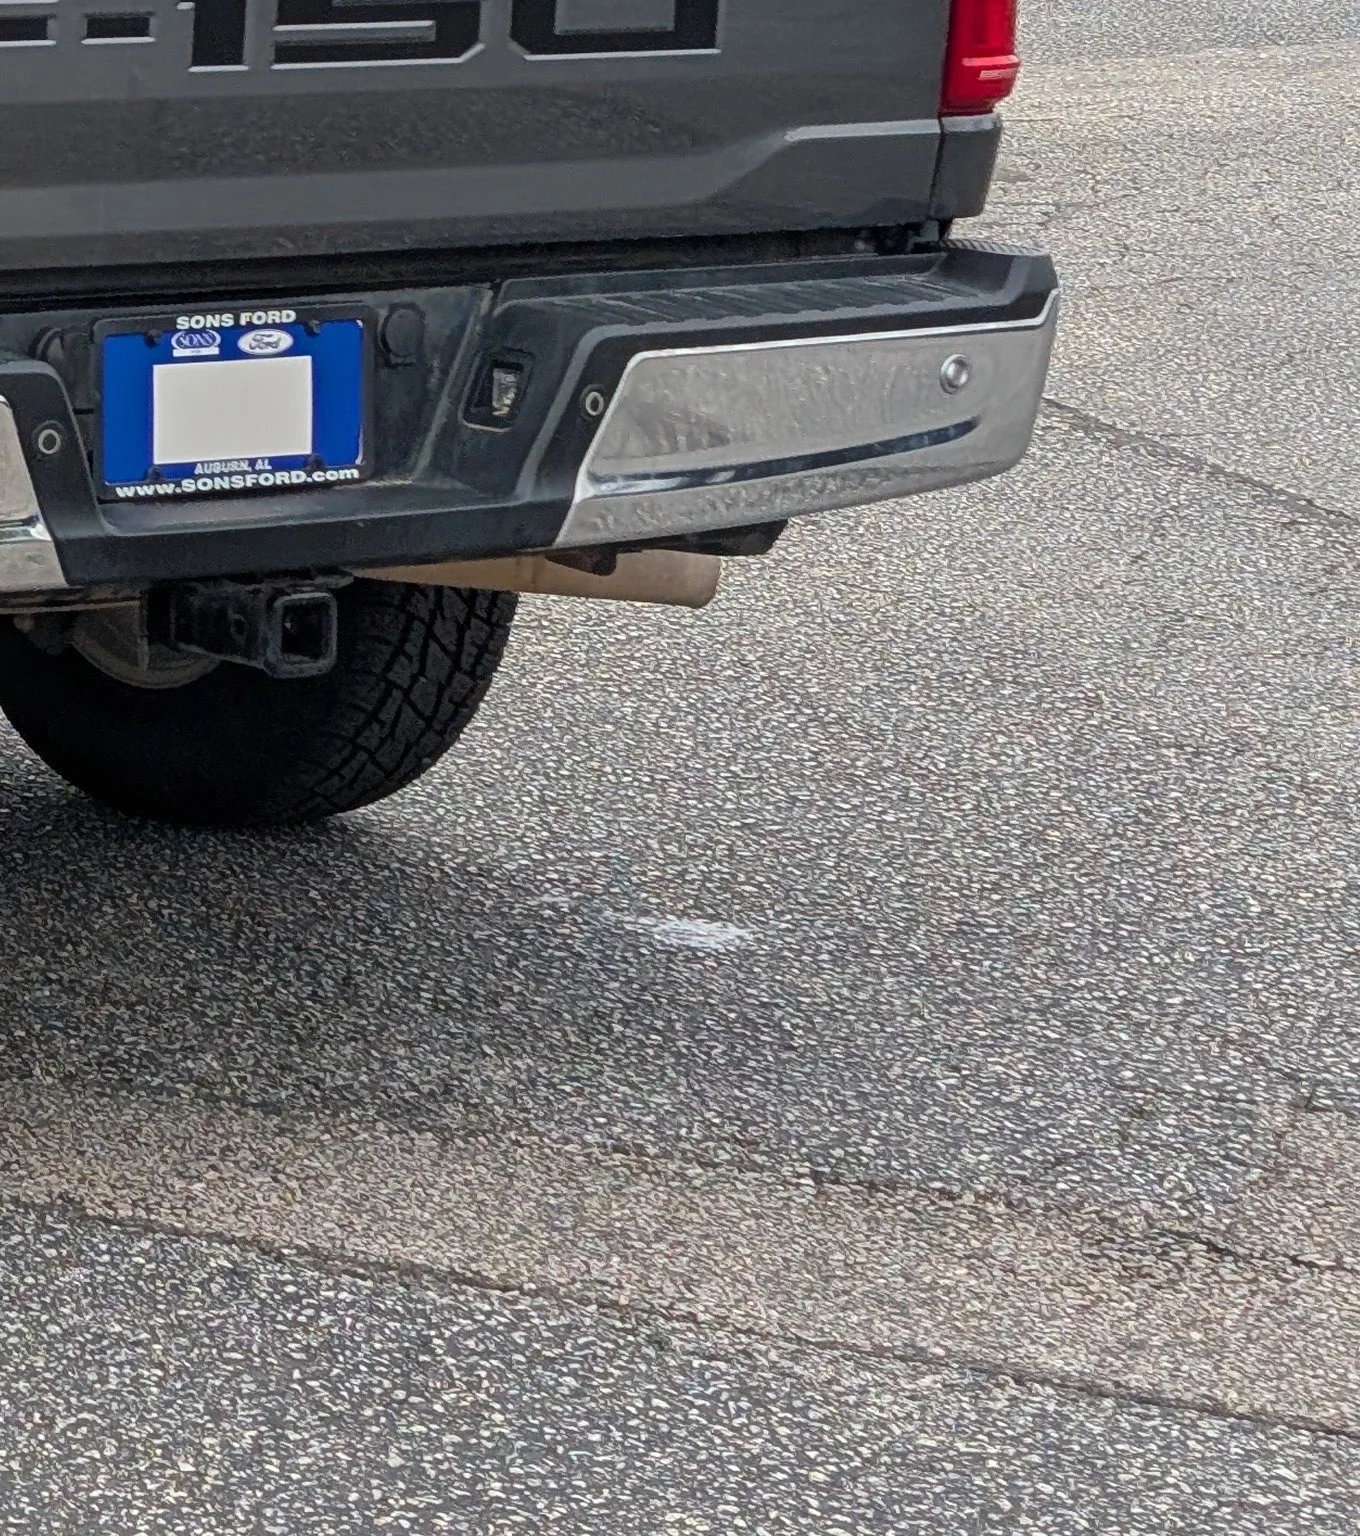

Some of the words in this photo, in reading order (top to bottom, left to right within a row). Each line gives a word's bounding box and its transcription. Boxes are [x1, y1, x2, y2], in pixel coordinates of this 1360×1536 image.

[176, 313, 235, 330] SONS
[240, 309, 297, 326] FORD
[254, 458, 273, 470] AL
[115, 467, 360, 498] www.SONSFORD.com
